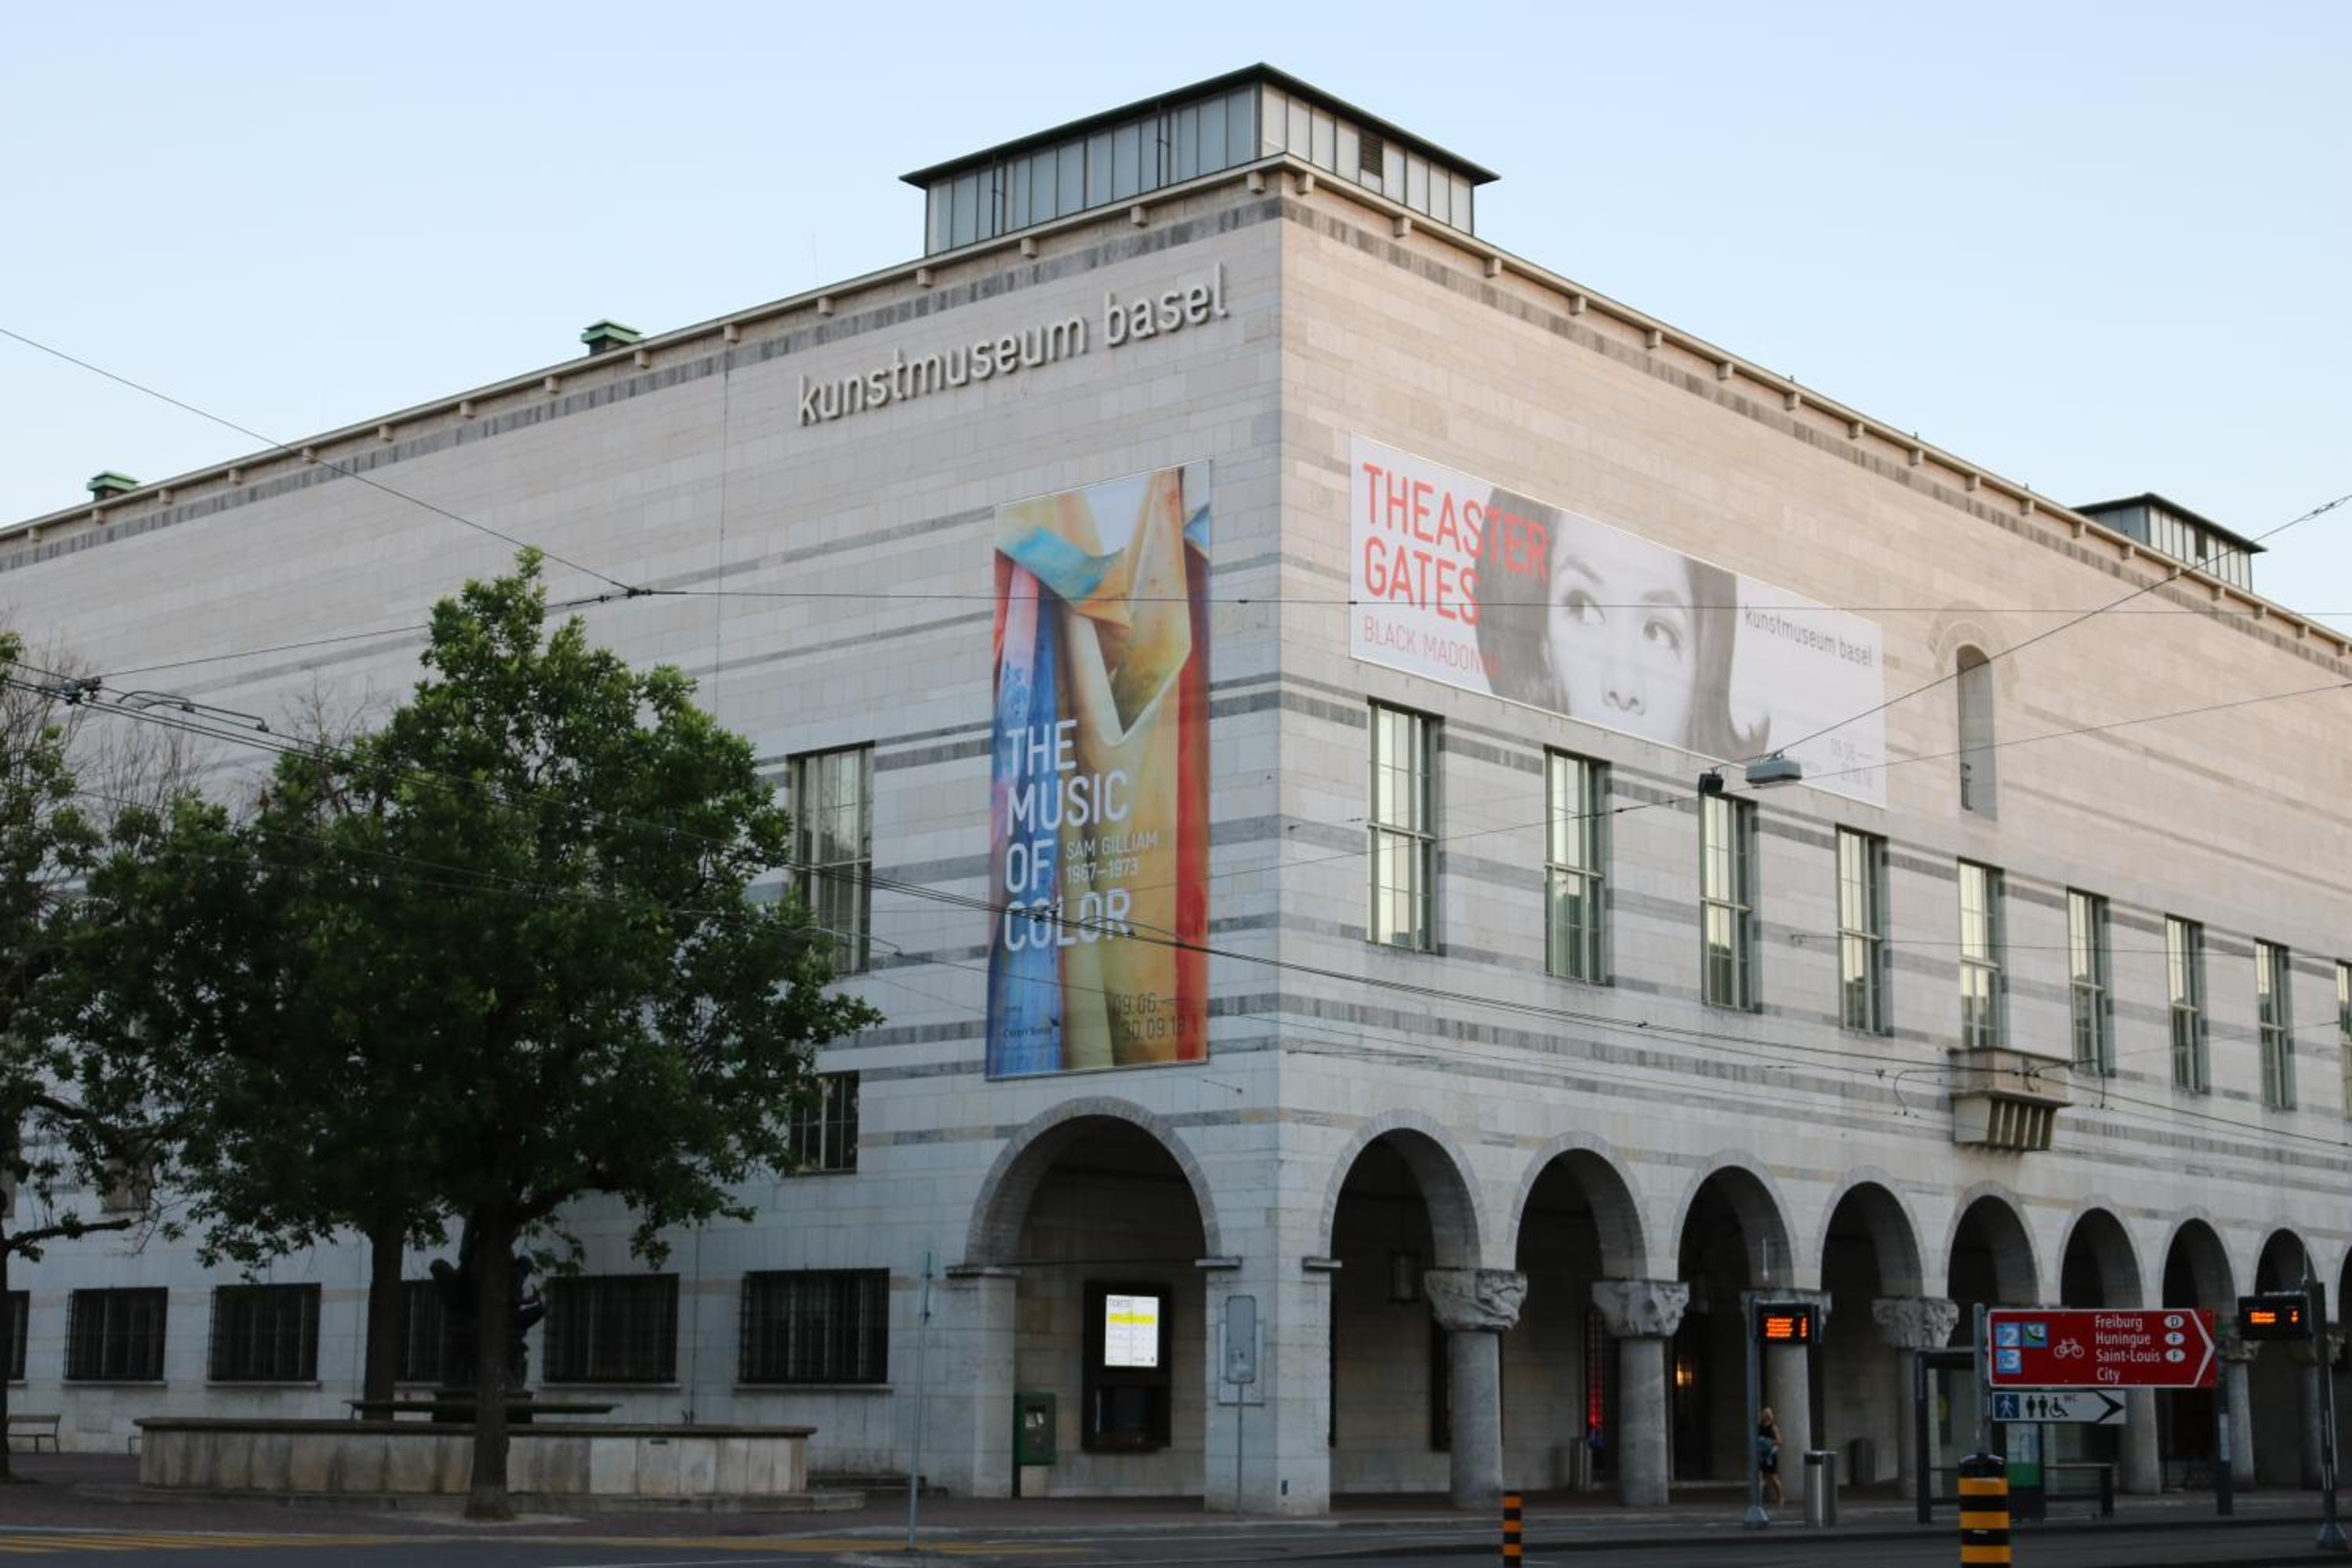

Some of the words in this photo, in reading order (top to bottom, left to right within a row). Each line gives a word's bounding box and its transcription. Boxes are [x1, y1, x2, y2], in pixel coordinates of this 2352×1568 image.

[797, 313, 1090, 426] kunstmuseum
[1103, 262, 1229, 347] basel
[1363, 463, 1549, 584] THEASTER
[1364, 536, 1481, 626] GATES
[1363, 615, 1417, 652] BLACK
[1744, 603, 1835, 656] kunstmuseum
[1839, 635, 1872, 666] basel
[1005, 720, 1077, 777] THE
[1007, 770, 1129, 836] MUSIC
[1005, 839, 1054, 894] OF
[1065, 837, 1096, 860] SAM
[1102, 830, 1159, 855] GILLIAM
[1004, 887, 1131, 952] COLOR
[2095, 1316, 2143, 1330] Freiburg
[2171, 1316, 2179, 1327] D
[2095, 1332, 2151, 1345] Huningue
[2096, 1349, 2161, 1363] Saint-Louis
[2097, 1367, 2120, 1382] City
